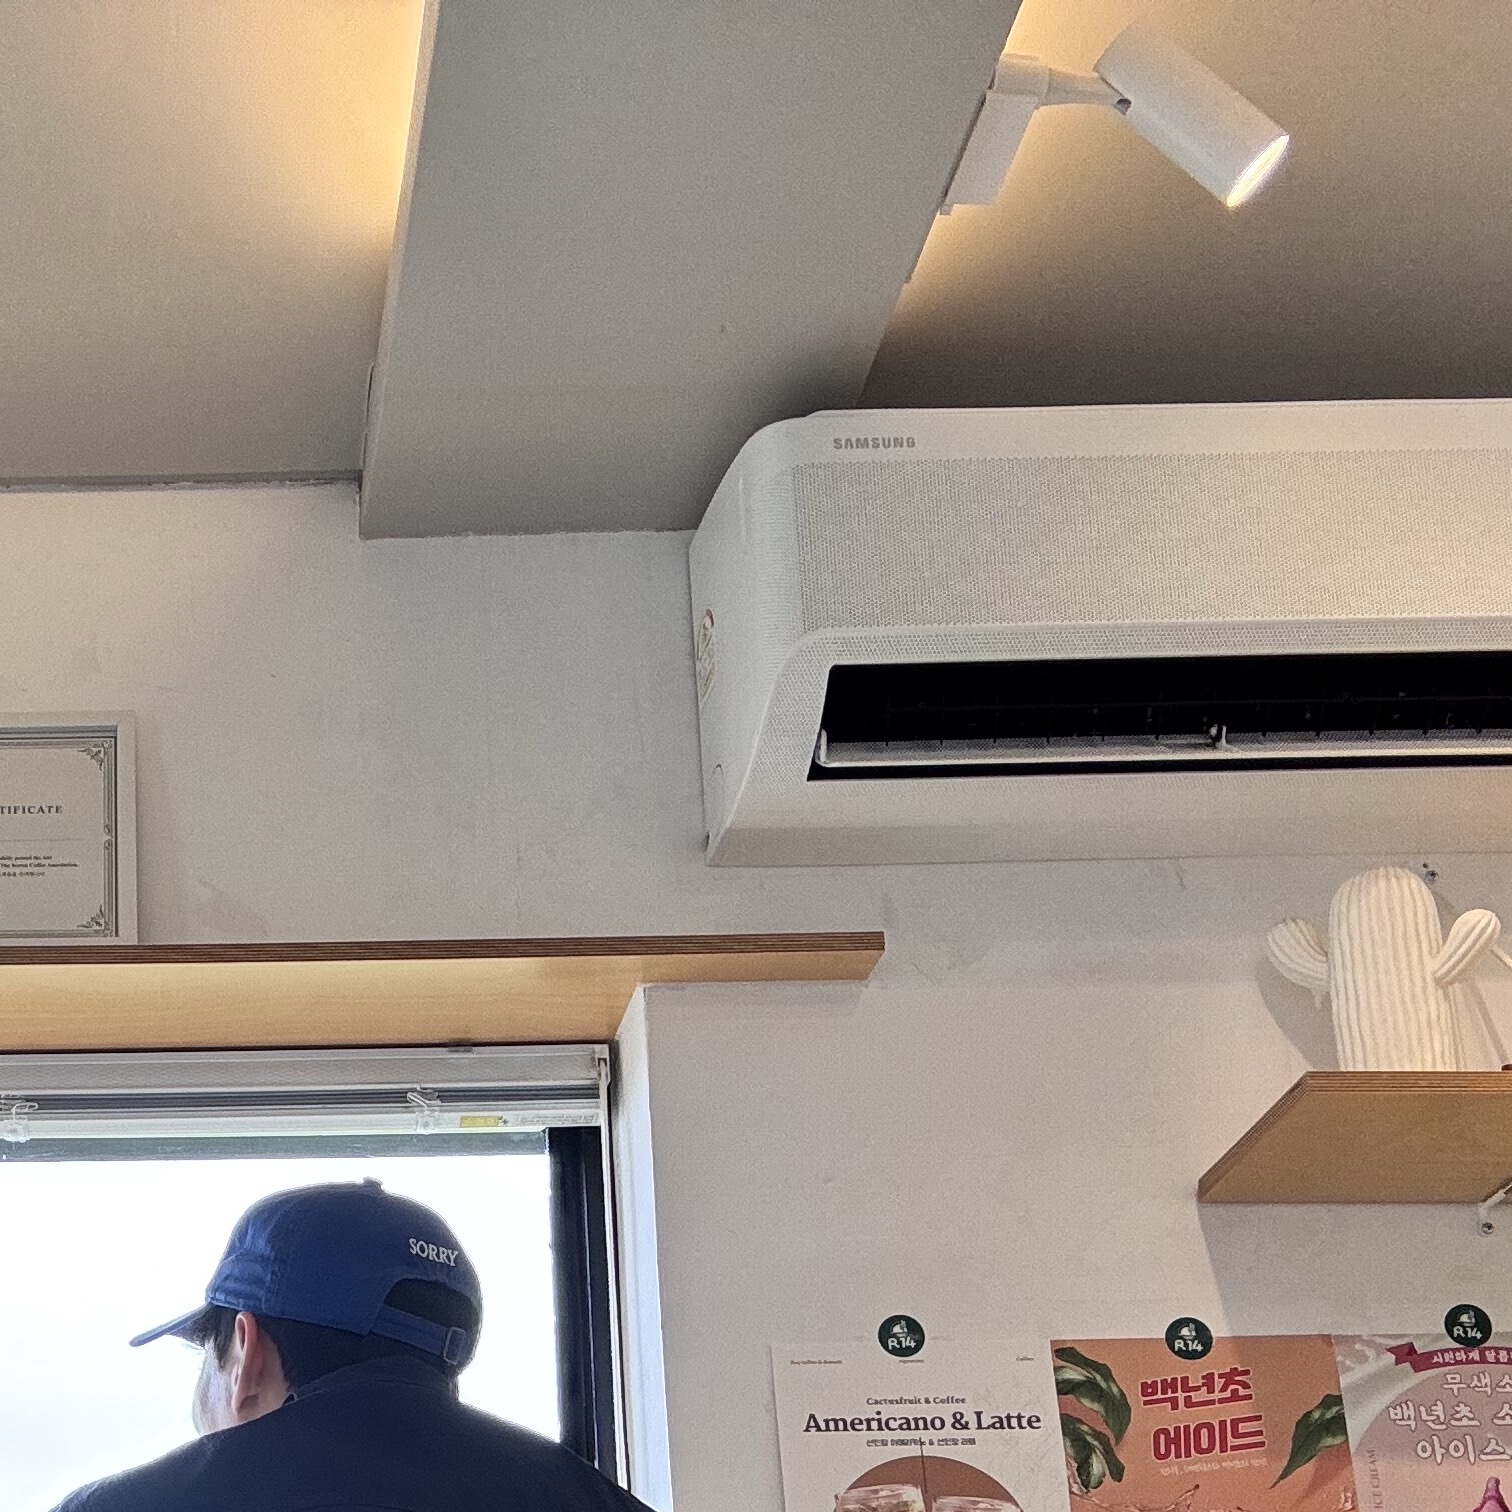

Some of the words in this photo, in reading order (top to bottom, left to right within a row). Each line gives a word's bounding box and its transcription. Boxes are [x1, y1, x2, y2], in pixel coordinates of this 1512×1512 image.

[833, 436, 916, 450] SAMSUNG
[409, 1238, 458, 1267] SORRY
[1432, 1348, 1481, 1364] 시원하게
[866, 1396, 922, 1405] Cactusfruit
[933, 1396, 967, 1405] Coffee
[1140, 1366, 1254, 1412] 백년초
[803, 1410, 946, 1433] Americano
[951, 1411, 971, 1431] &
[975, 1410, 1042, 1430] Latte
[1388, 1400, 1481, 1432] 백년초
[1152, 1414, 1266, 1461] 에이드
